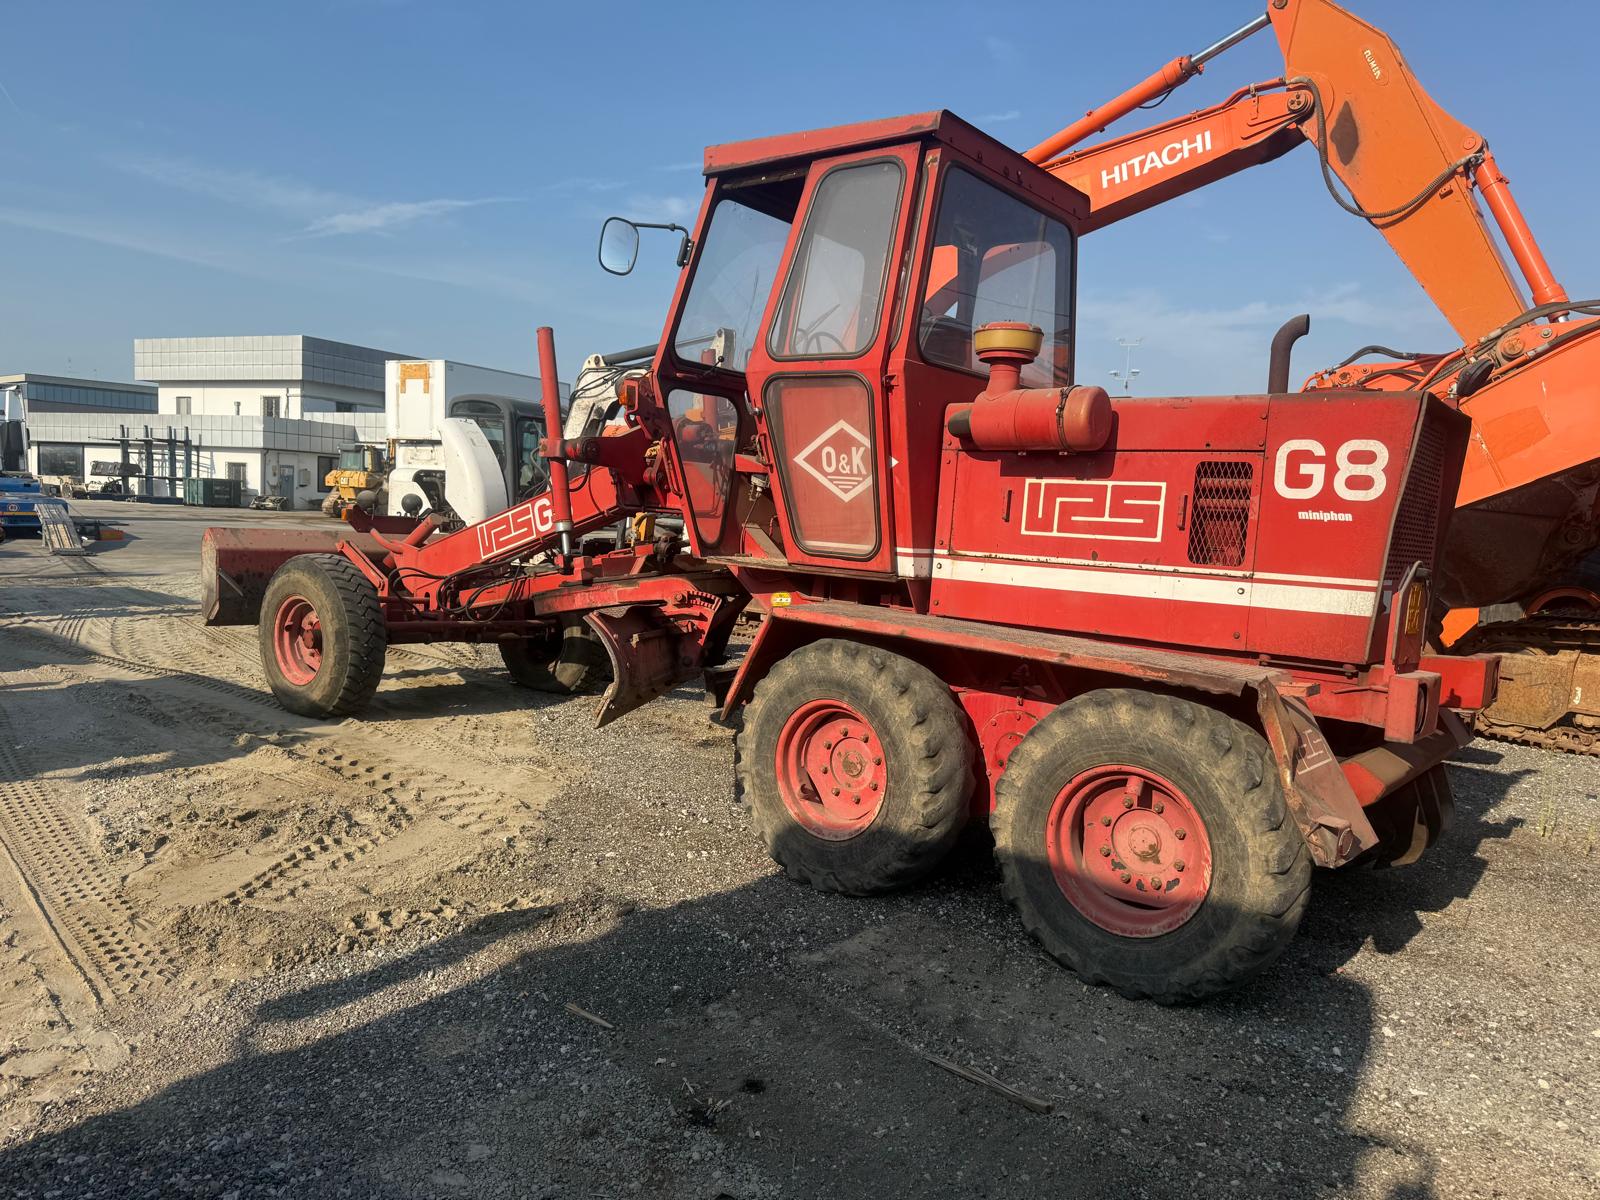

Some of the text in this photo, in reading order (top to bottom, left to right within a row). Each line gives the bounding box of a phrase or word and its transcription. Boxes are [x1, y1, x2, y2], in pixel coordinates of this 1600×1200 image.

[1101, 130, 1212, 189] HITACHI
[821, 446, 867, 474] O&K
[1274, 439, 1389, 501] G8
[533, 497, 555, 533] G
[1297, 509, 1353, 522] miniphon
